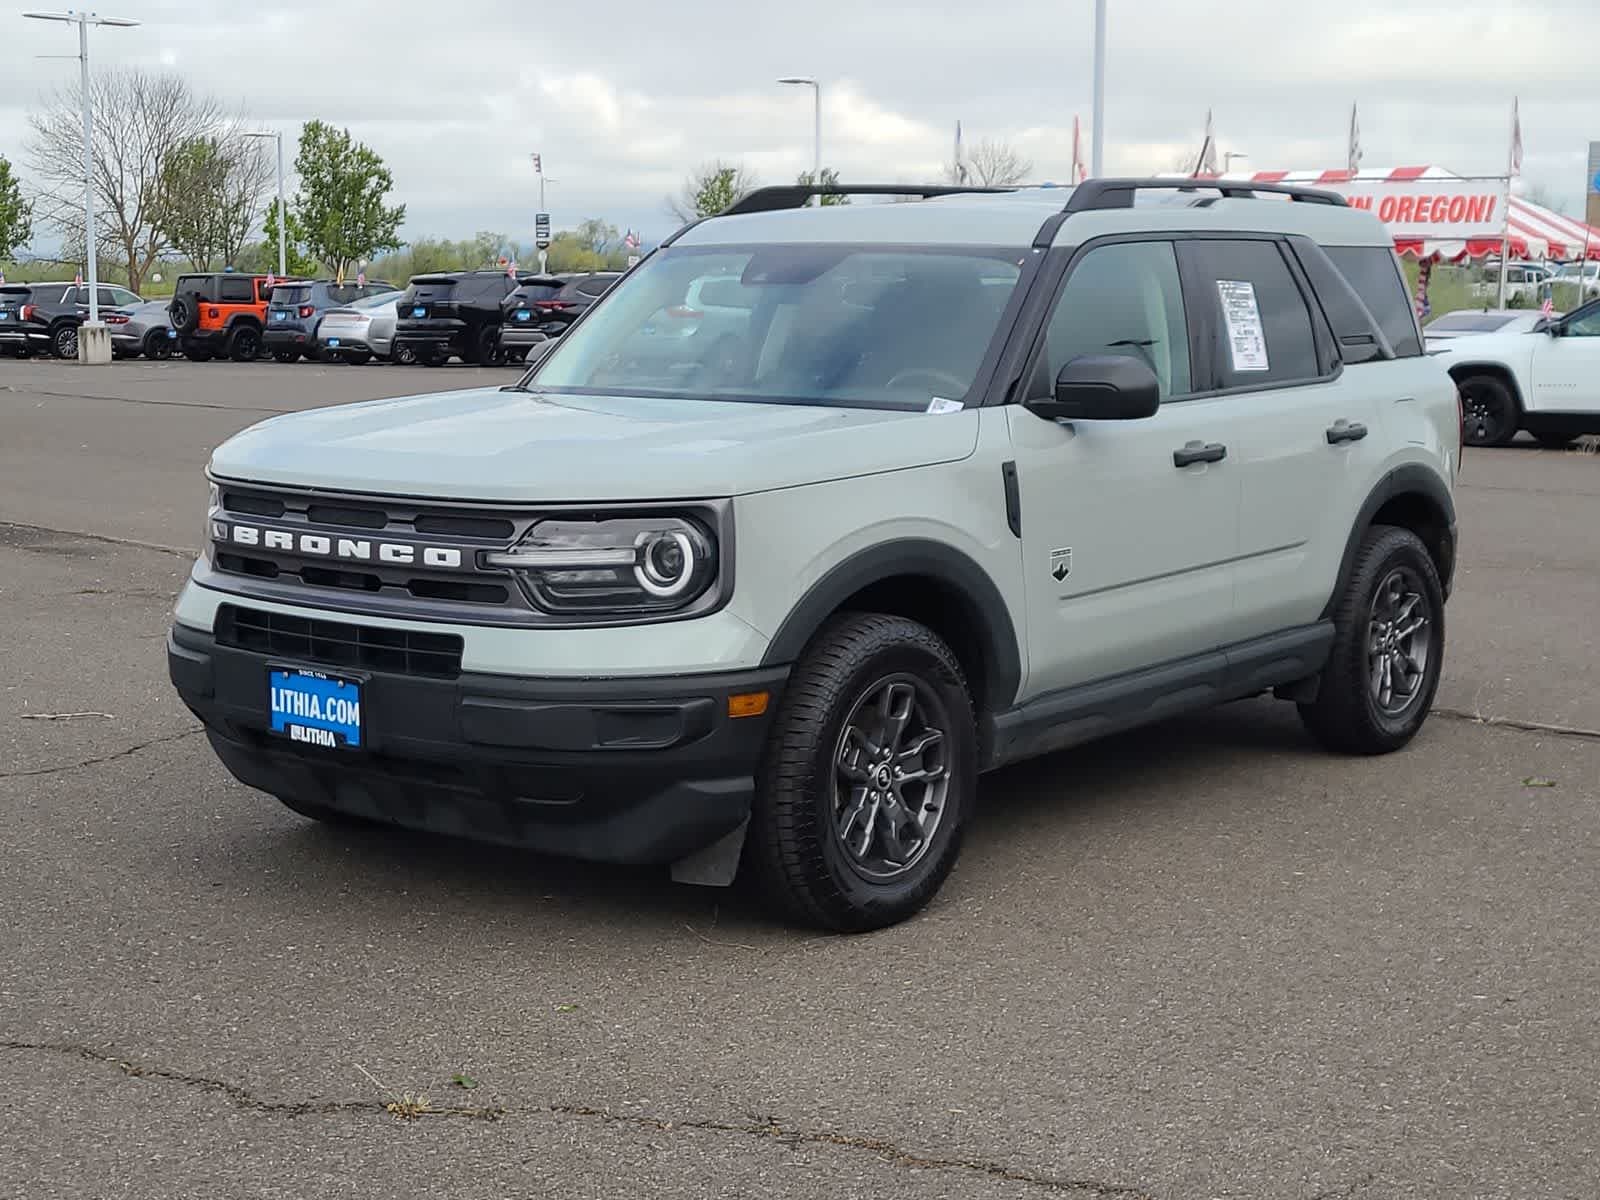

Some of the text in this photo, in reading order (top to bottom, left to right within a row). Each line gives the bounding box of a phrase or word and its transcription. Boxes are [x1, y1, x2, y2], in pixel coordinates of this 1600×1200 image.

[1378, 194, 1497, 224] OREGON!
[233, 525, 461, 567] BRONCO
[271, 687, 360, 727] LITHIA.COM
[302, 726, 336, 748] LITHIA
